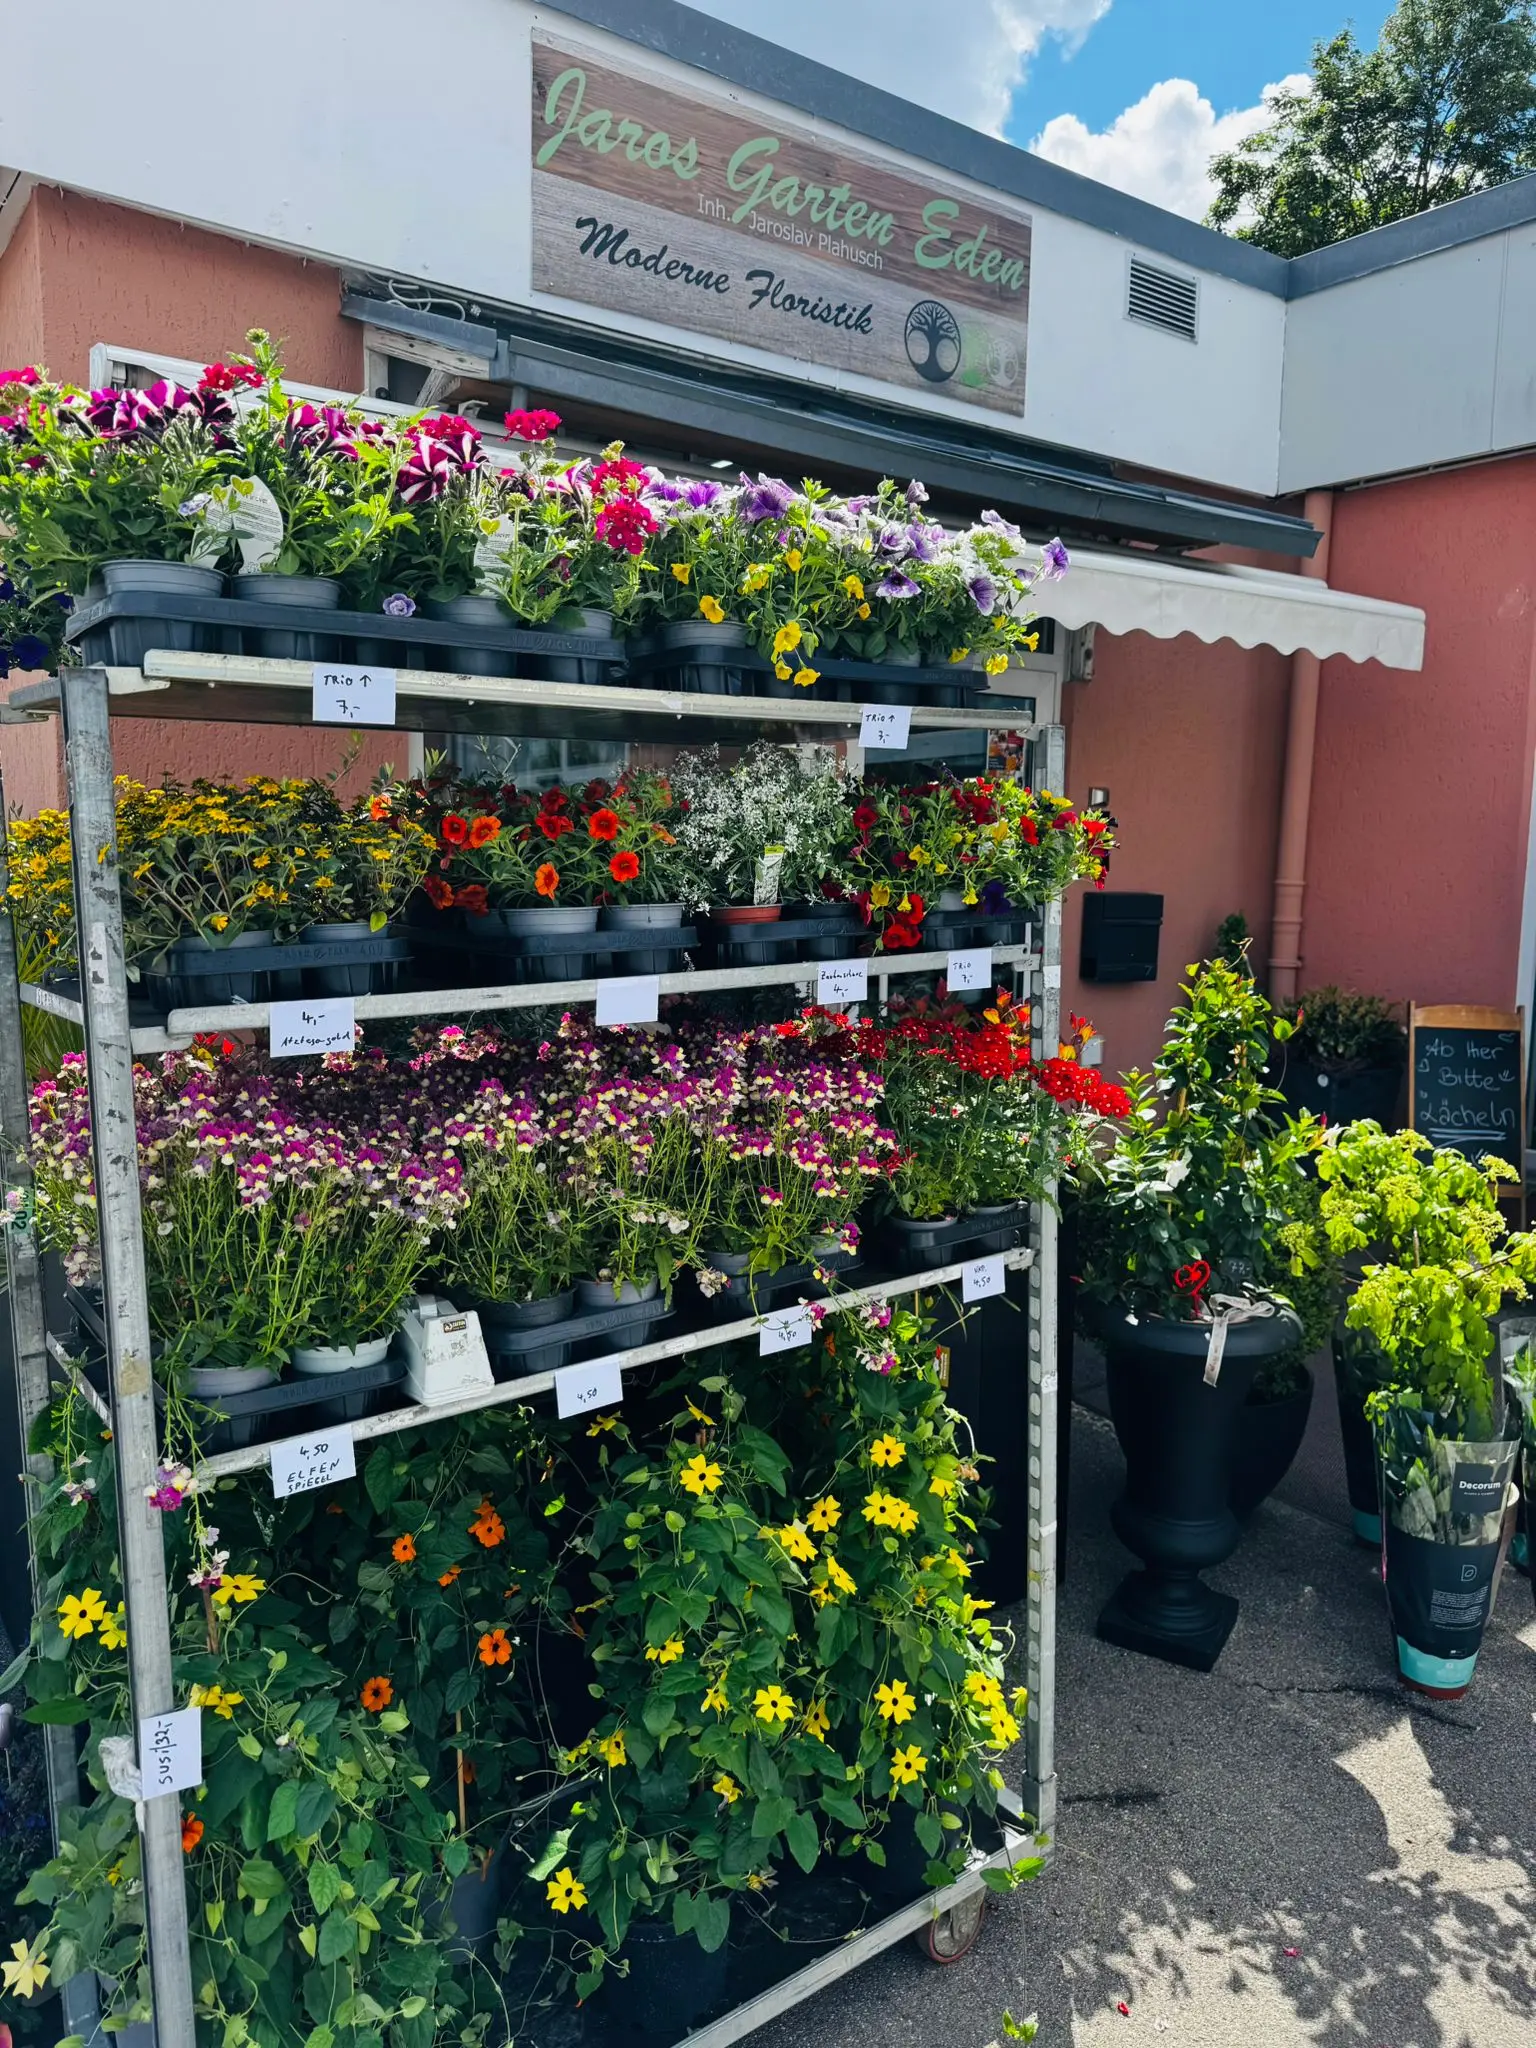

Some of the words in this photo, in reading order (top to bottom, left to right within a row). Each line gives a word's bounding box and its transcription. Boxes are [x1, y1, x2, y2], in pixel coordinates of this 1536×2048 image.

[537, 68, 699, 179] Jaros
[726, 137, 895, 246] Garten
[914, 199, 1025, 290] Eden
[697, 193, 731, 221] Inh.
[748, 211, 814, 247] Jaroslav
[818, 233, 883, 270] Plahusch
[575, 216, 730, 294] Moderne
[745, 269, 874, 335] Floristik
[302, 1011, 325, 1025] 4,-
[1425, 1038, 1455, 1057] Ab
[1438, 1066, 1501, 1091] Bitte
[1420, 1098, 1516, 1129] Lächeln
[577, 1388, 598, 1403] 4,50
[300, 1443, 329, 1460] 4,50
[287, 1458, 341, 1483] ELFEN
[1459, 1481, 1501, 1490] Decorum
